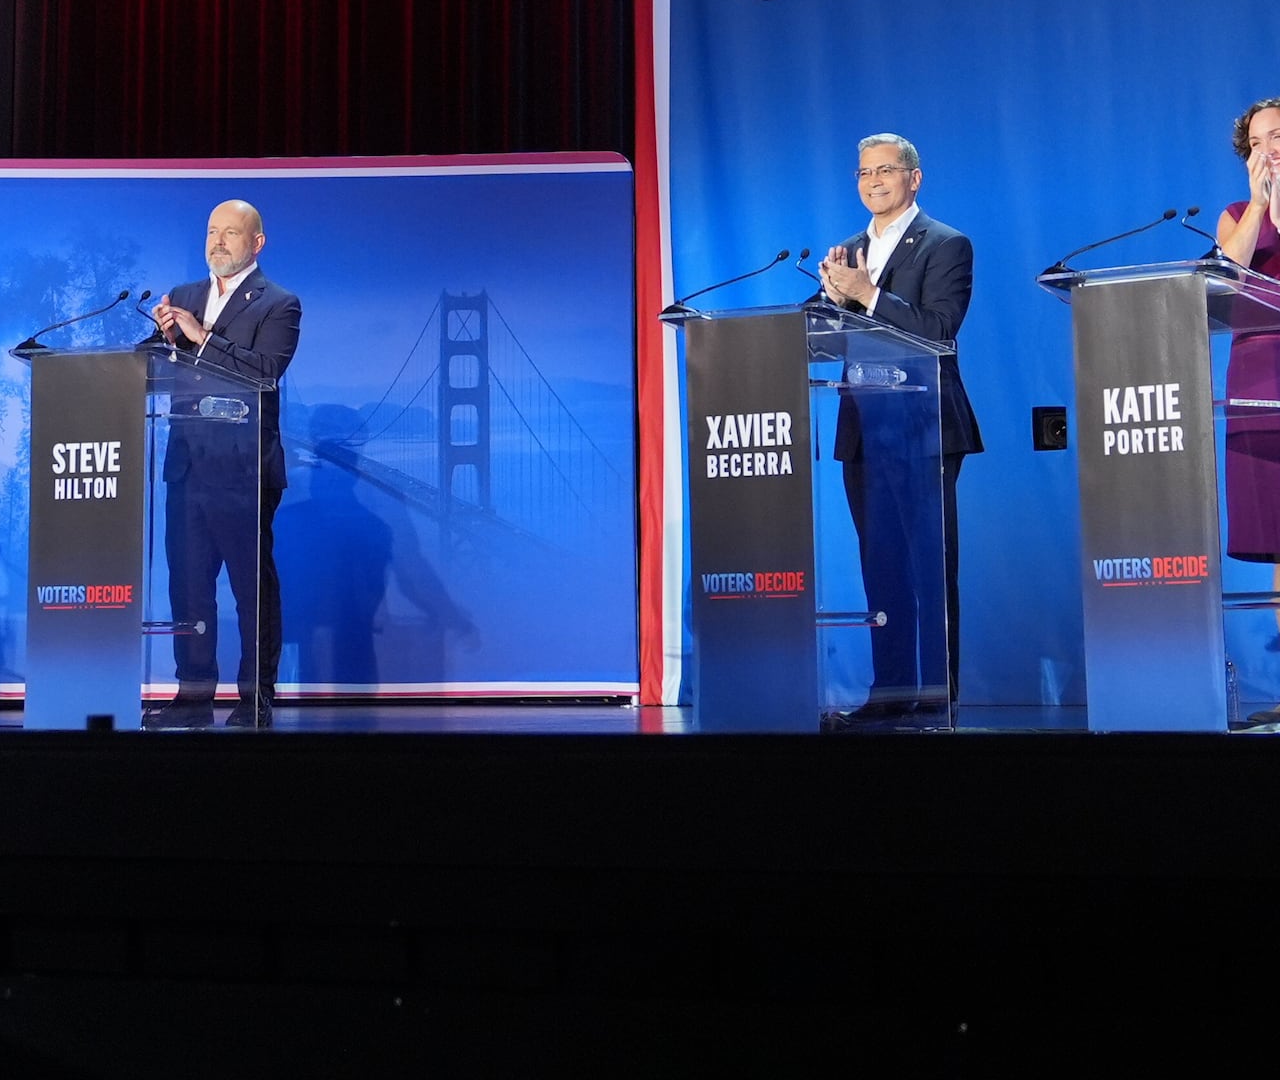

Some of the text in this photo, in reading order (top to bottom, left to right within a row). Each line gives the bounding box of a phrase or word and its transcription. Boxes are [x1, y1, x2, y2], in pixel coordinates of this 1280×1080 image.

[1103, 383, 1181, 424] KATIE
[706, 411, 792, 449] XAVIER
[1104, 426, 1184, 455] PORTER
[52, 441, 121, 474] STEVE
[706, 451, 793, 478] BECERRA
[54, 477, 117, 500] HILTON
[1093, 555, 1208, 580] VOTERS DECIDE
[37, 585, 133, 603] VOTERS DECIDE
[701, 571, 804, 593] VOTERS DECIDE
